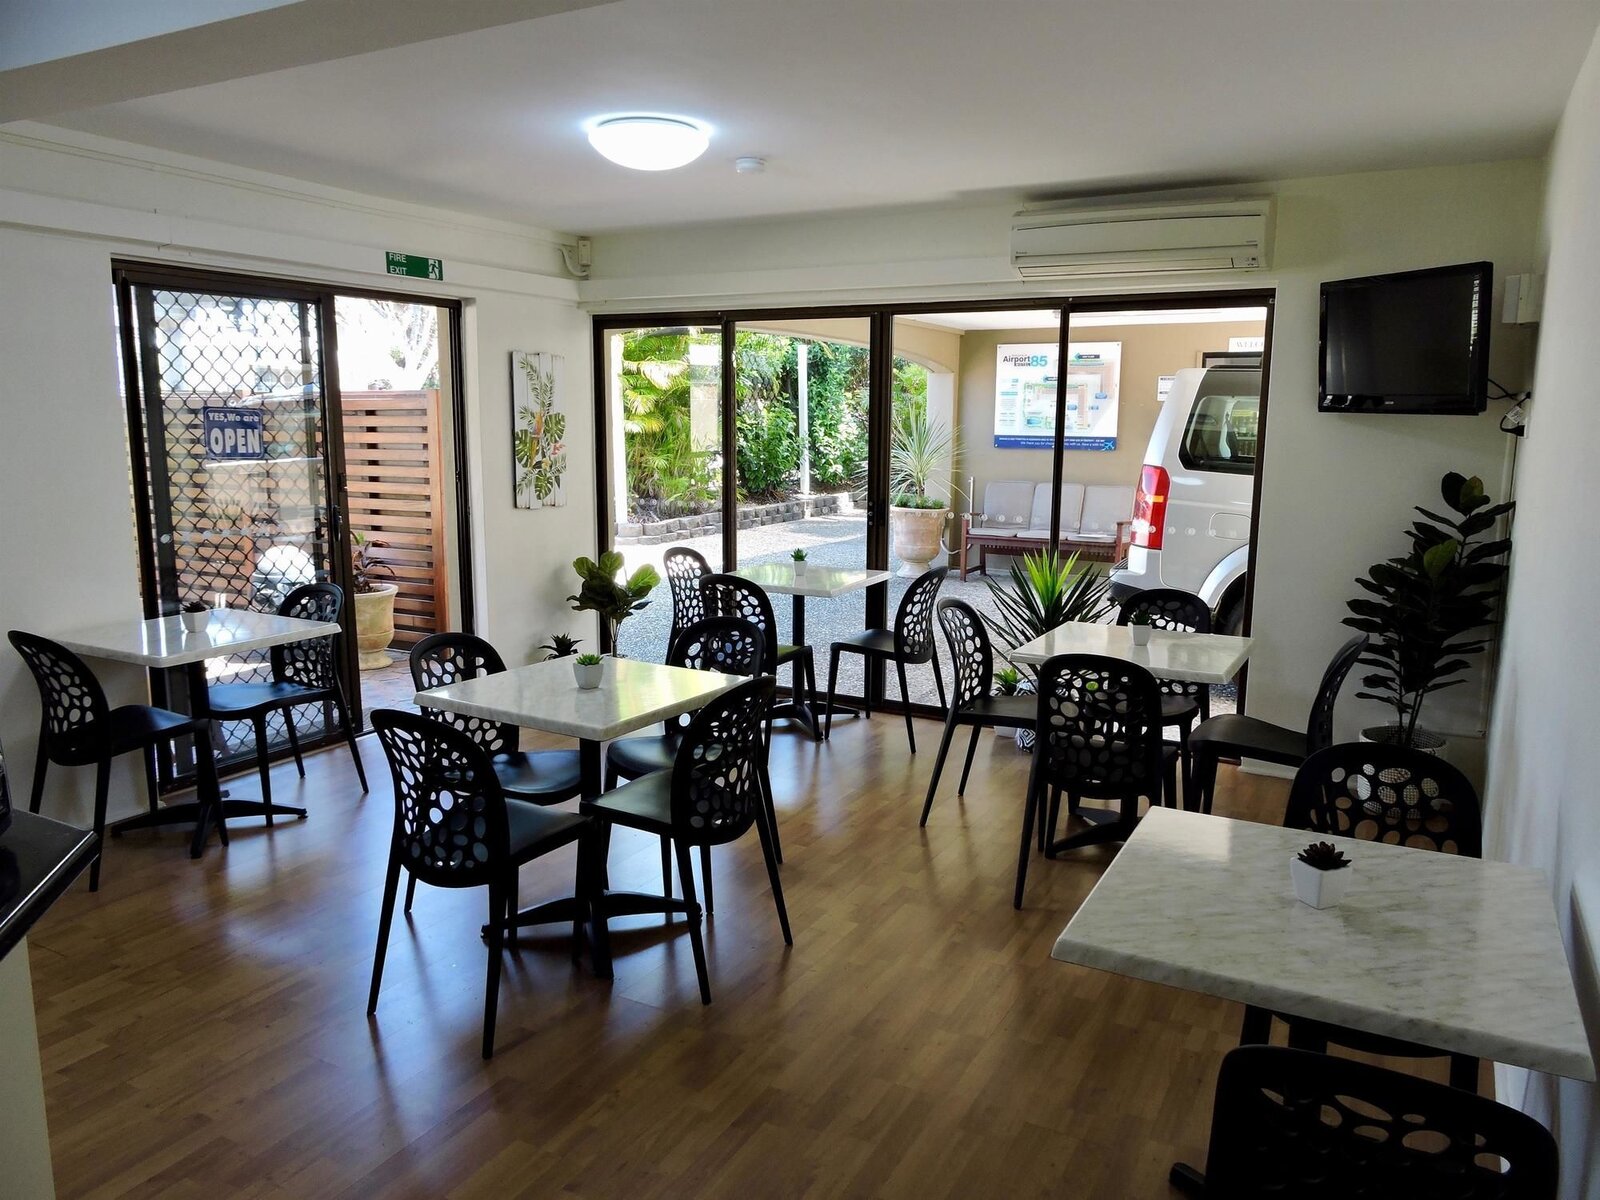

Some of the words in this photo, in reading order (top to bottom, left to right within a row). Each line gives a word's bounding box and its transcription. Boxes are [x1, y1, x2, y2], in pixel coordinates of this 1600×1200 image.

[389, 252, 407, 263] FIRE
[390, 265, 407, 275] EXIT
[1003, 355, 1031, 364] Airport
[1031, 355, 1048, 367] 85
[210, 427, 261, 454] OPEN
